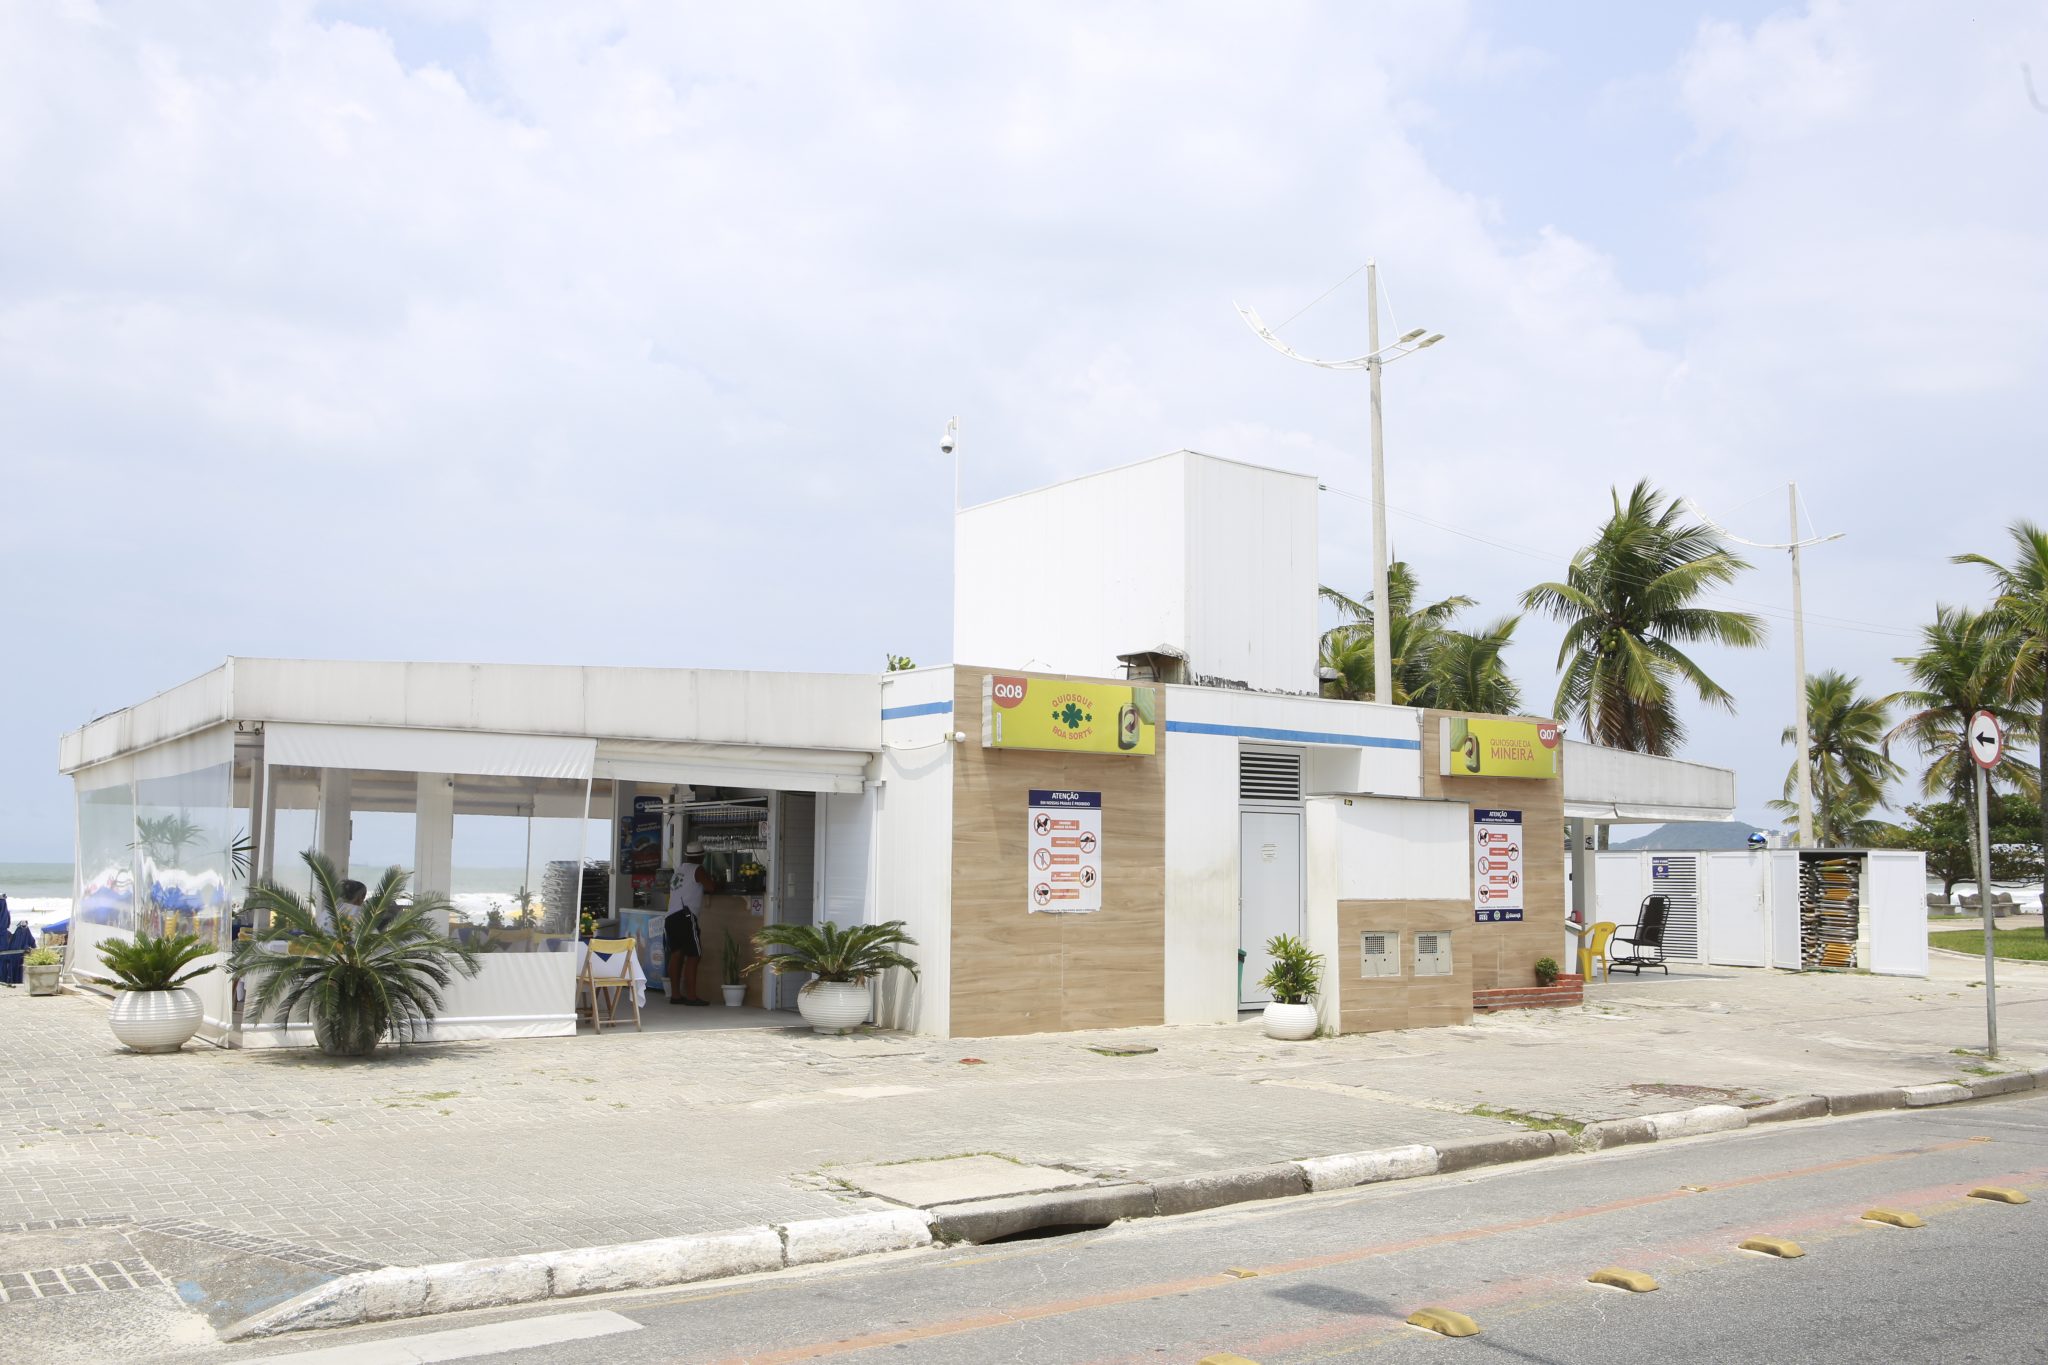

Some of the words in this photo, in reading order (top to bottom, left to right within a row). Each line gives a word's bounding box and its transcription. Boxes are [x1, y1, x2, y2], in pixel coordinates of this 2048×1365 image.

[995, 684, 1023, 699] Q08
[1052, 694, 1093, 709] QUIOSQUE
[1053, 725, 1067, 739] BOA
[1069, 727, 1092, 740] SORTE
[1540, 729, 1556, 740] Q07
[1491, 747, 1535, 761] MINEIRA
[1051, 791, 1079, 800] ATENÇÃO
